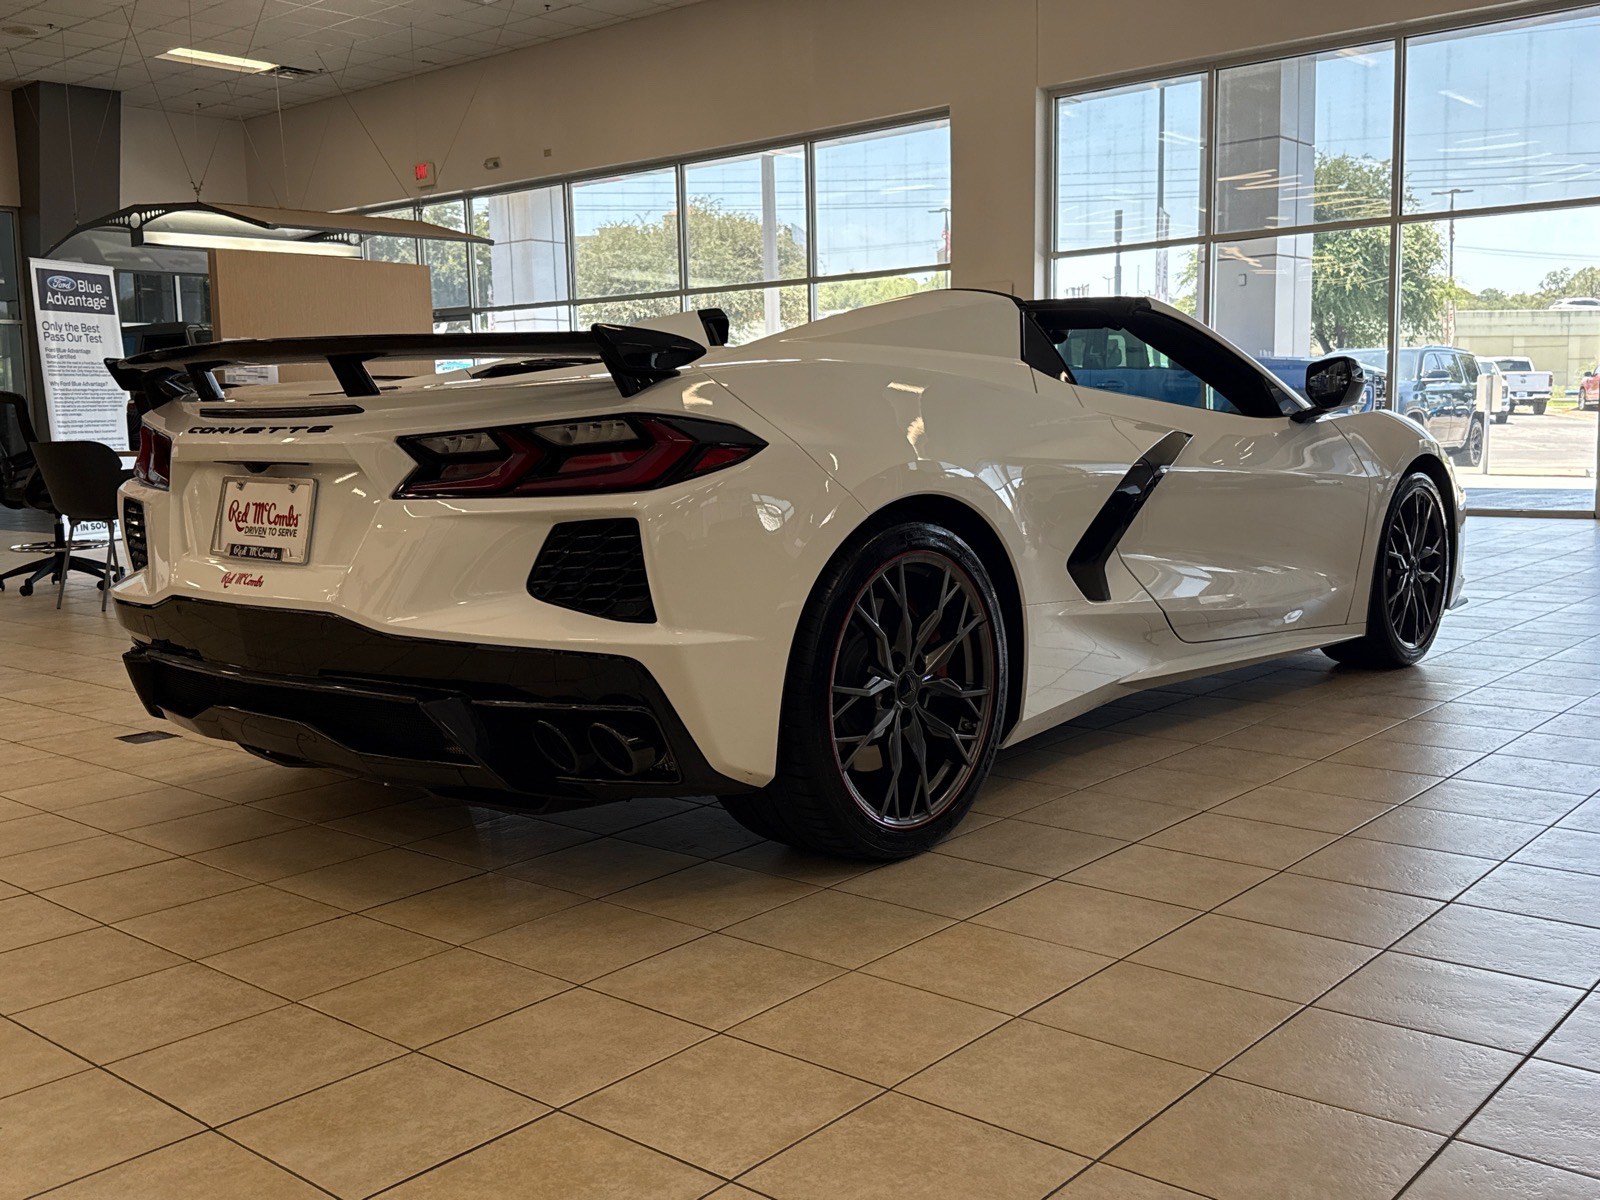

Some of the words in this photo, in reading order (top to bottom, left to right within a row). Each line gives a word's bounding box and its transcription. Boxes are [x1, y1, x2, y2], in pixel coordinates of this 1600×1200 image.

[52, 277, 71, 289] Ford
[77, 280, 102, 294] Blue
[42, 320, 63, 333] Only
[64, 321, 80, 332] the
[80, 323, 100, 334] Best
[43, 331, 65, 342] Pass
[66, 332, 82, 343] Our
[84, 333, 103, 343] Test
[188, 425, 334, 434] CORVETTE
[228, 500, 250, 532] Red
[252, 501, 299, 528] McCombs
[80, 523, 89, 531] IN
[244, 526, 267, 536] DRIVEN
[268, 527, 277, 537] TO
[278, 528, 298, 538] SERVE
[233, 545, 247, 558] Red
[221, 571, 236, 588] Red
[235, 572, 264, 588] McCombs
